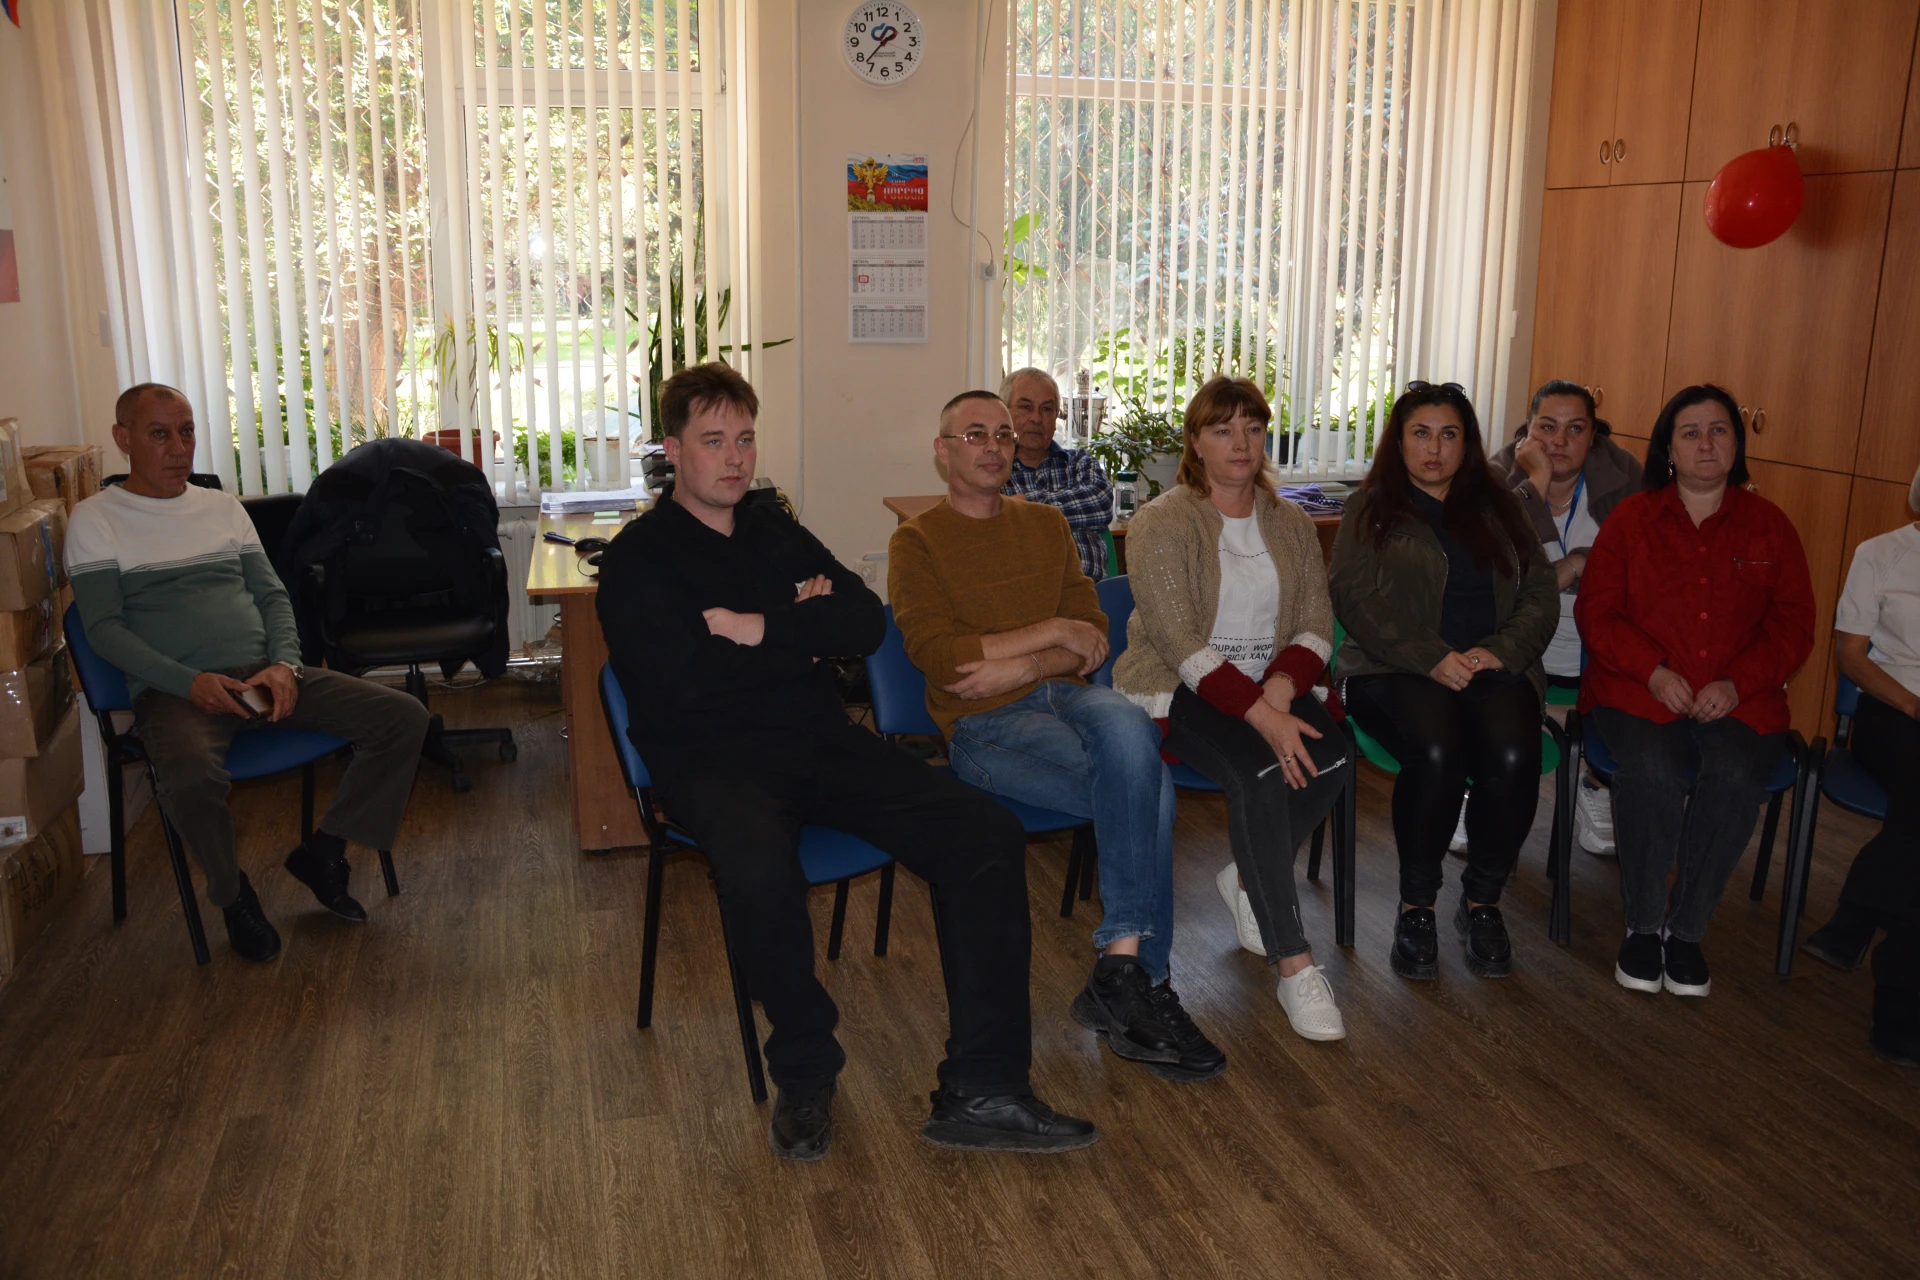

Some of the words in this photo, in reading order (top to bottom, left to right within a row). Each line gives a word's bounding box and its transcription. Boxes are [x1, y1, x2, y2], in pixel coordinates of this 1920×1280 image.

[864, 12, 873, 21] 11
[876, 6, 889, 17] 12
[895, 12, 899, 21] 1
[854, 22, 866, 32] 10
[903, 22, 911, 32] 2
[850, 37, 859, 47] 9
[909, 37, 917, 47] 3
[856, 52, 864, 62] 8
[904, 52, 913, 61] 4
[867, 62, 874, 72] 7
[881, 67, 889, 77] 6
[895, 62, 903, 72] 5
[1253, 644, 1273, 652] WOP
